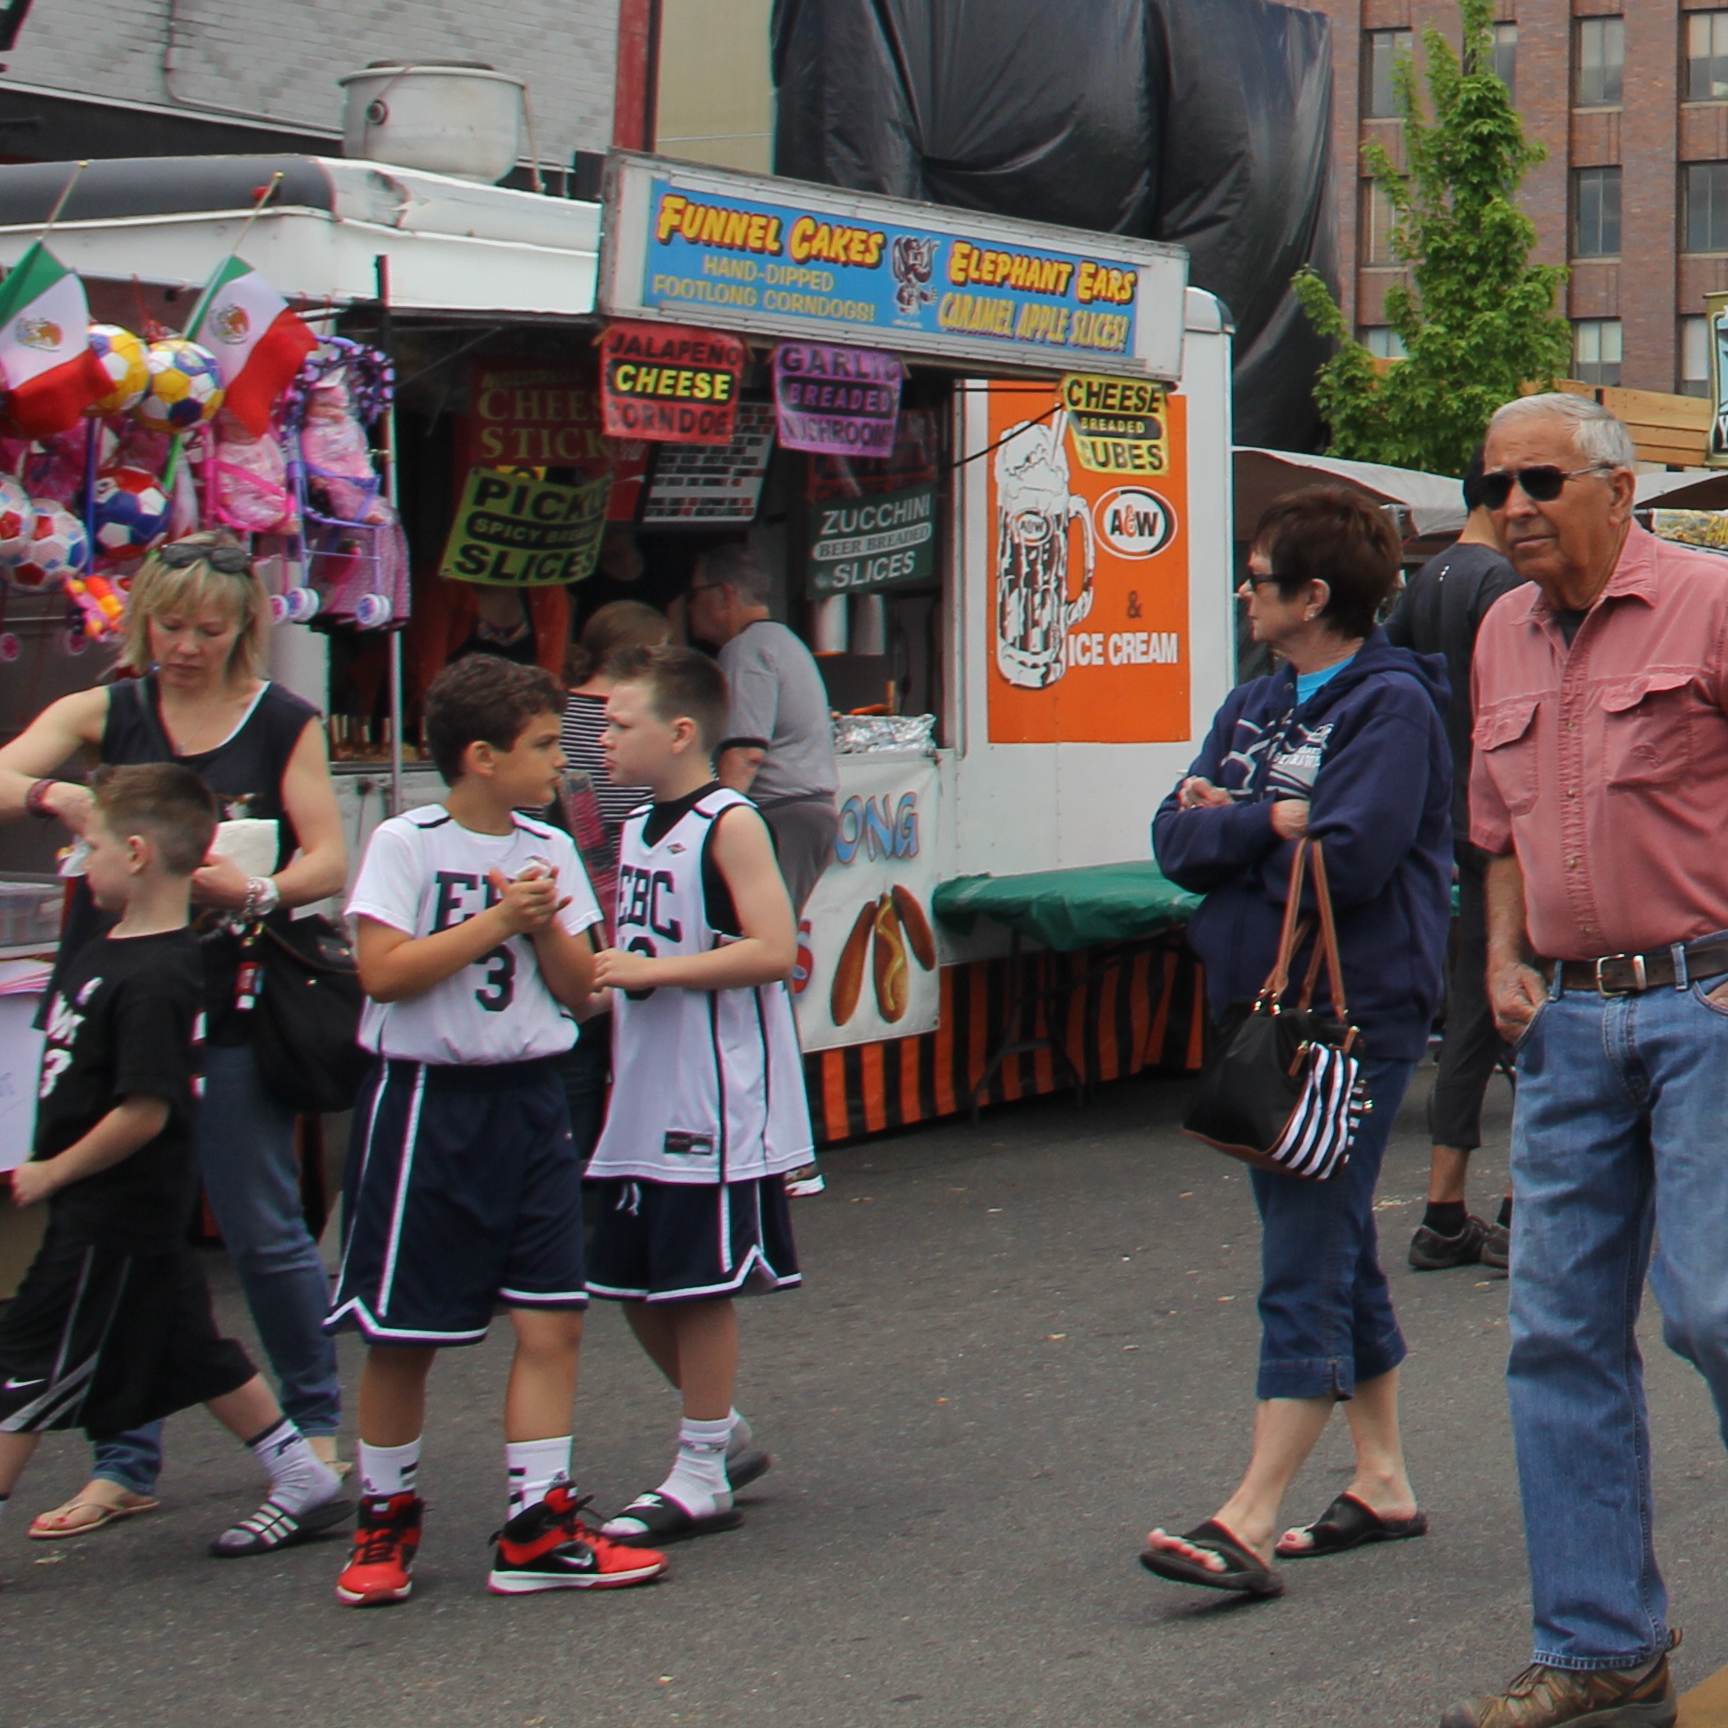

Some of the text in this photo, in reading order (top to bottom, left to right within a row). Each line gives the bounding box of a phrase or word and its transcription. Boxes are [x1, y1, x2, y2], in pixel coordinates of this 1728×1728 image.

[656, 193, 887, 269] FUNNEL CAKES
[702, 254, 836, 293] HAND-DIPPED
[948, 239, 1139, 305] ELEPHANT EARS
[651, 273, 876, 322] FOOTLONG CORNDOGS!
[937, 291, 1131, 353] CARAMEL APPLE SLICES!
[607, 333, 741, 367] JALAPEÑO
[781, 346, 902, 381] GARLIC
[614, 364, 733, 401] CHEESE
[788, 382, 891, 413] BREADED
[1066, 379, 1163, 415] CHEESE
[477, 388, 601, 421] CHEES
[1080, 417, 1146, 435] BREADED
[471, 517, 545, 542] SPICY
[820, 492, 931, 535] ZUCCHINI
[1109, 503, 1159, 540] A&W
[819, 524, 930, 557] BEER BREADED
[832, 551, 916, 588] SLICES
[1126, 590, 1142, 619] &
[1068, 632, 1178, 667] ICE CREAM
[834, 791, 920, 866] ONG
[617, 864, 683, 943] EBC
[473, 944, 517, 1012] 3
